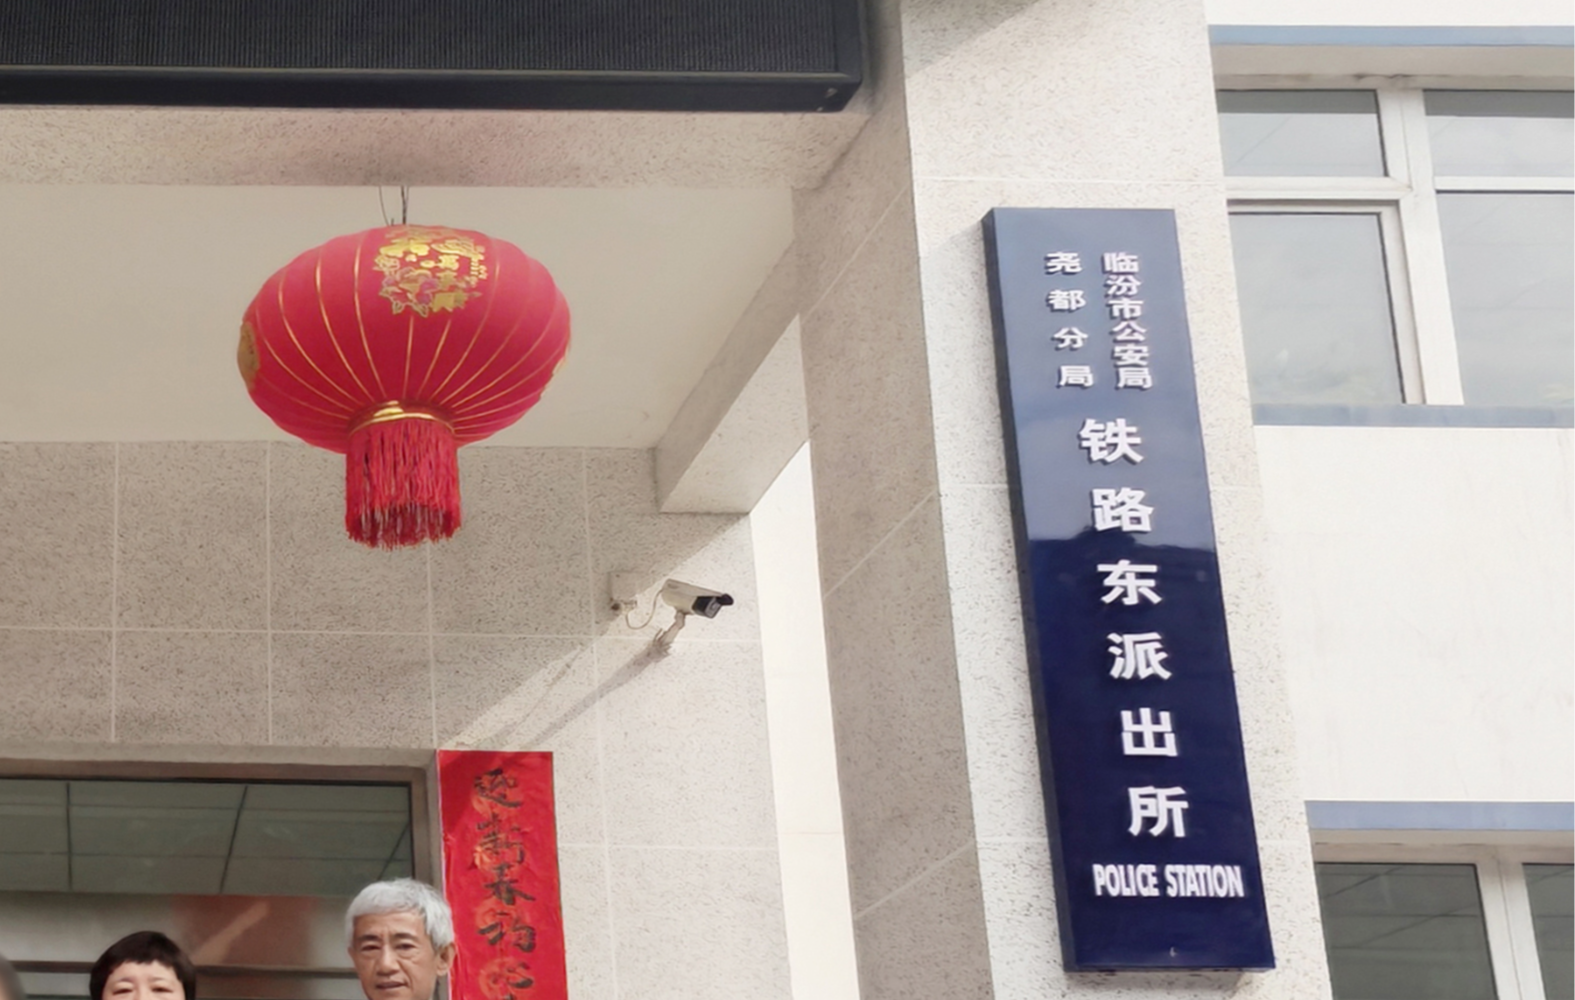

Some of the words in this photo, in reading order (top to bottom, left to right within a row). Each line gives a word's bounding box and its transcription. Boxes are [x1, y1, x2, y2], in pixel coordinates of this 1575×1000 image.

[1044, 251, 1095, 388] 尧都分局
[1102, 251, 1153, 390] 临汾市公安局
[1079, 417, 1190, 838] 铁路东派出所
[1092, 863, 1161, 897] POLICE
[1164, 863, 1245, 898] STATION
